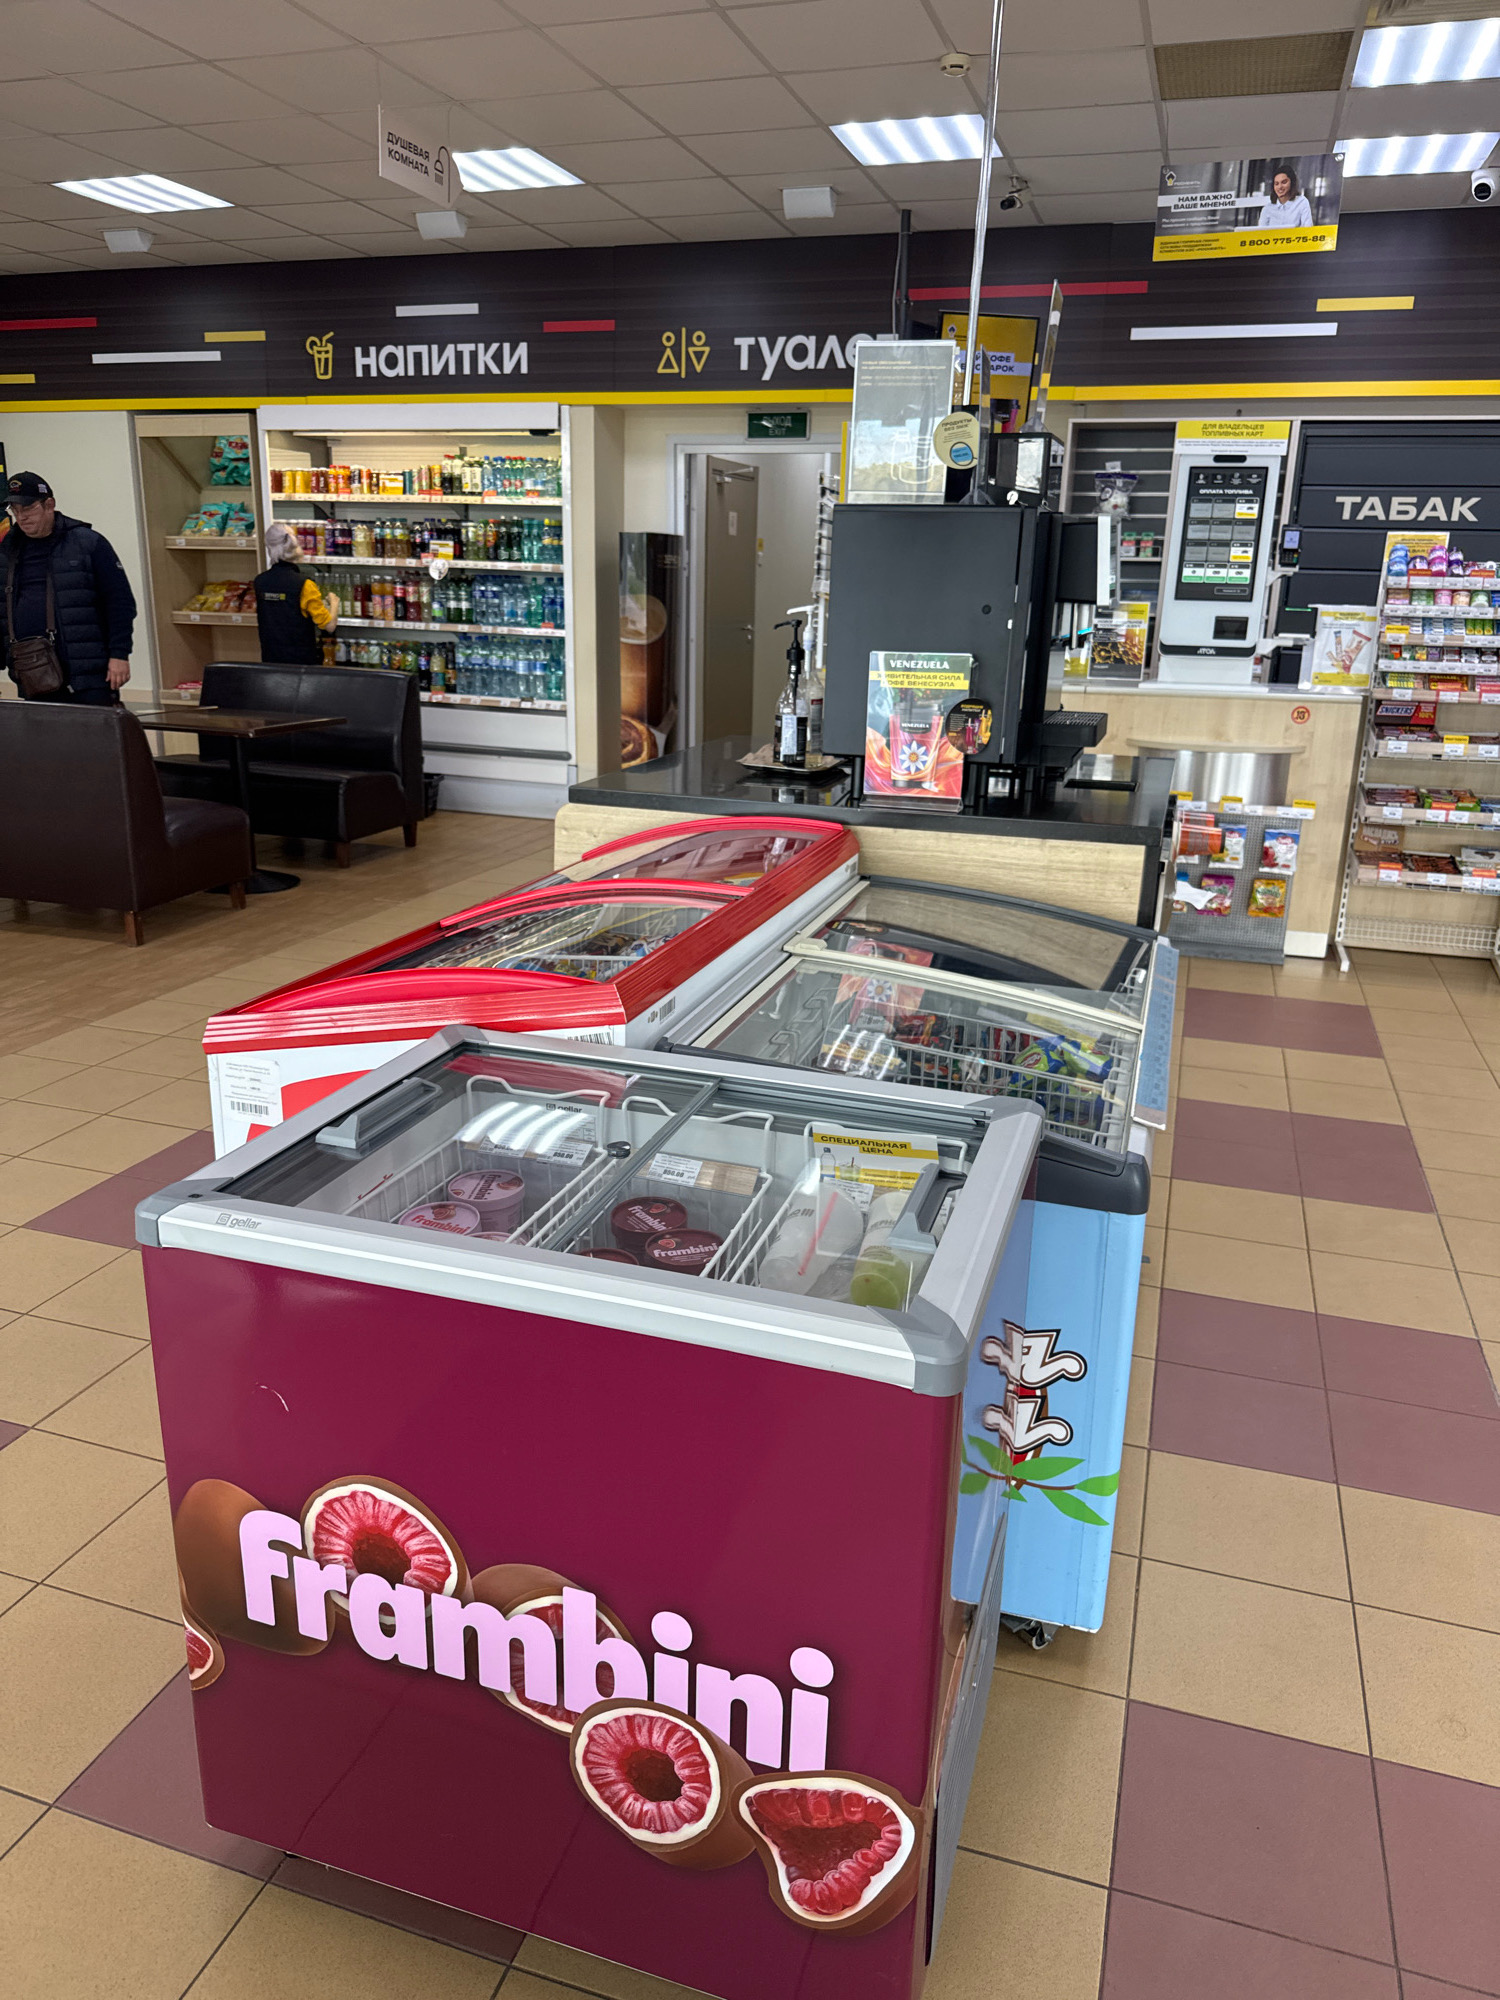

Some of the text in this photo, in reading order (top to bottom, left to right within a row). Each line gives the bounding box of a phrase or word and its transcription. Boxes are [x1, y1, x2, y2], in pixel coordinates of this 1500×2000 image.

[387, 131, 430, 162] ДУШЕВАЯ
[387, 147, 430, 177] КОМНАТА
[1173, 200, 1236, 210] ВАШЕ МНЕНИЕ
[1178, 193, 1233, 203] НАМ ВАЖНО
[1248, 238, 1271, 246] 800
[1272, 235, 1326, 245] 775-75-88
[354, 342, 530, 378] напитки
[733, 333, 900, 381] туале
[1335, 496, 1481, 522] ТАБАК
[889, 660, 950, 670] VENEZUELA
[907, 680, 955, 688] ВЕНЕСУЭЛА
[1379, 706, 1414, 715] SNICKERS
[821, 1135, 908, 1150] СПЕЦИАЛЬНАЯ
[862, 1147, 894, 1155] ЦЕНА
[229, 1216, 262, 1230] gellar
[239, 1510, 834, 1772] frambini
